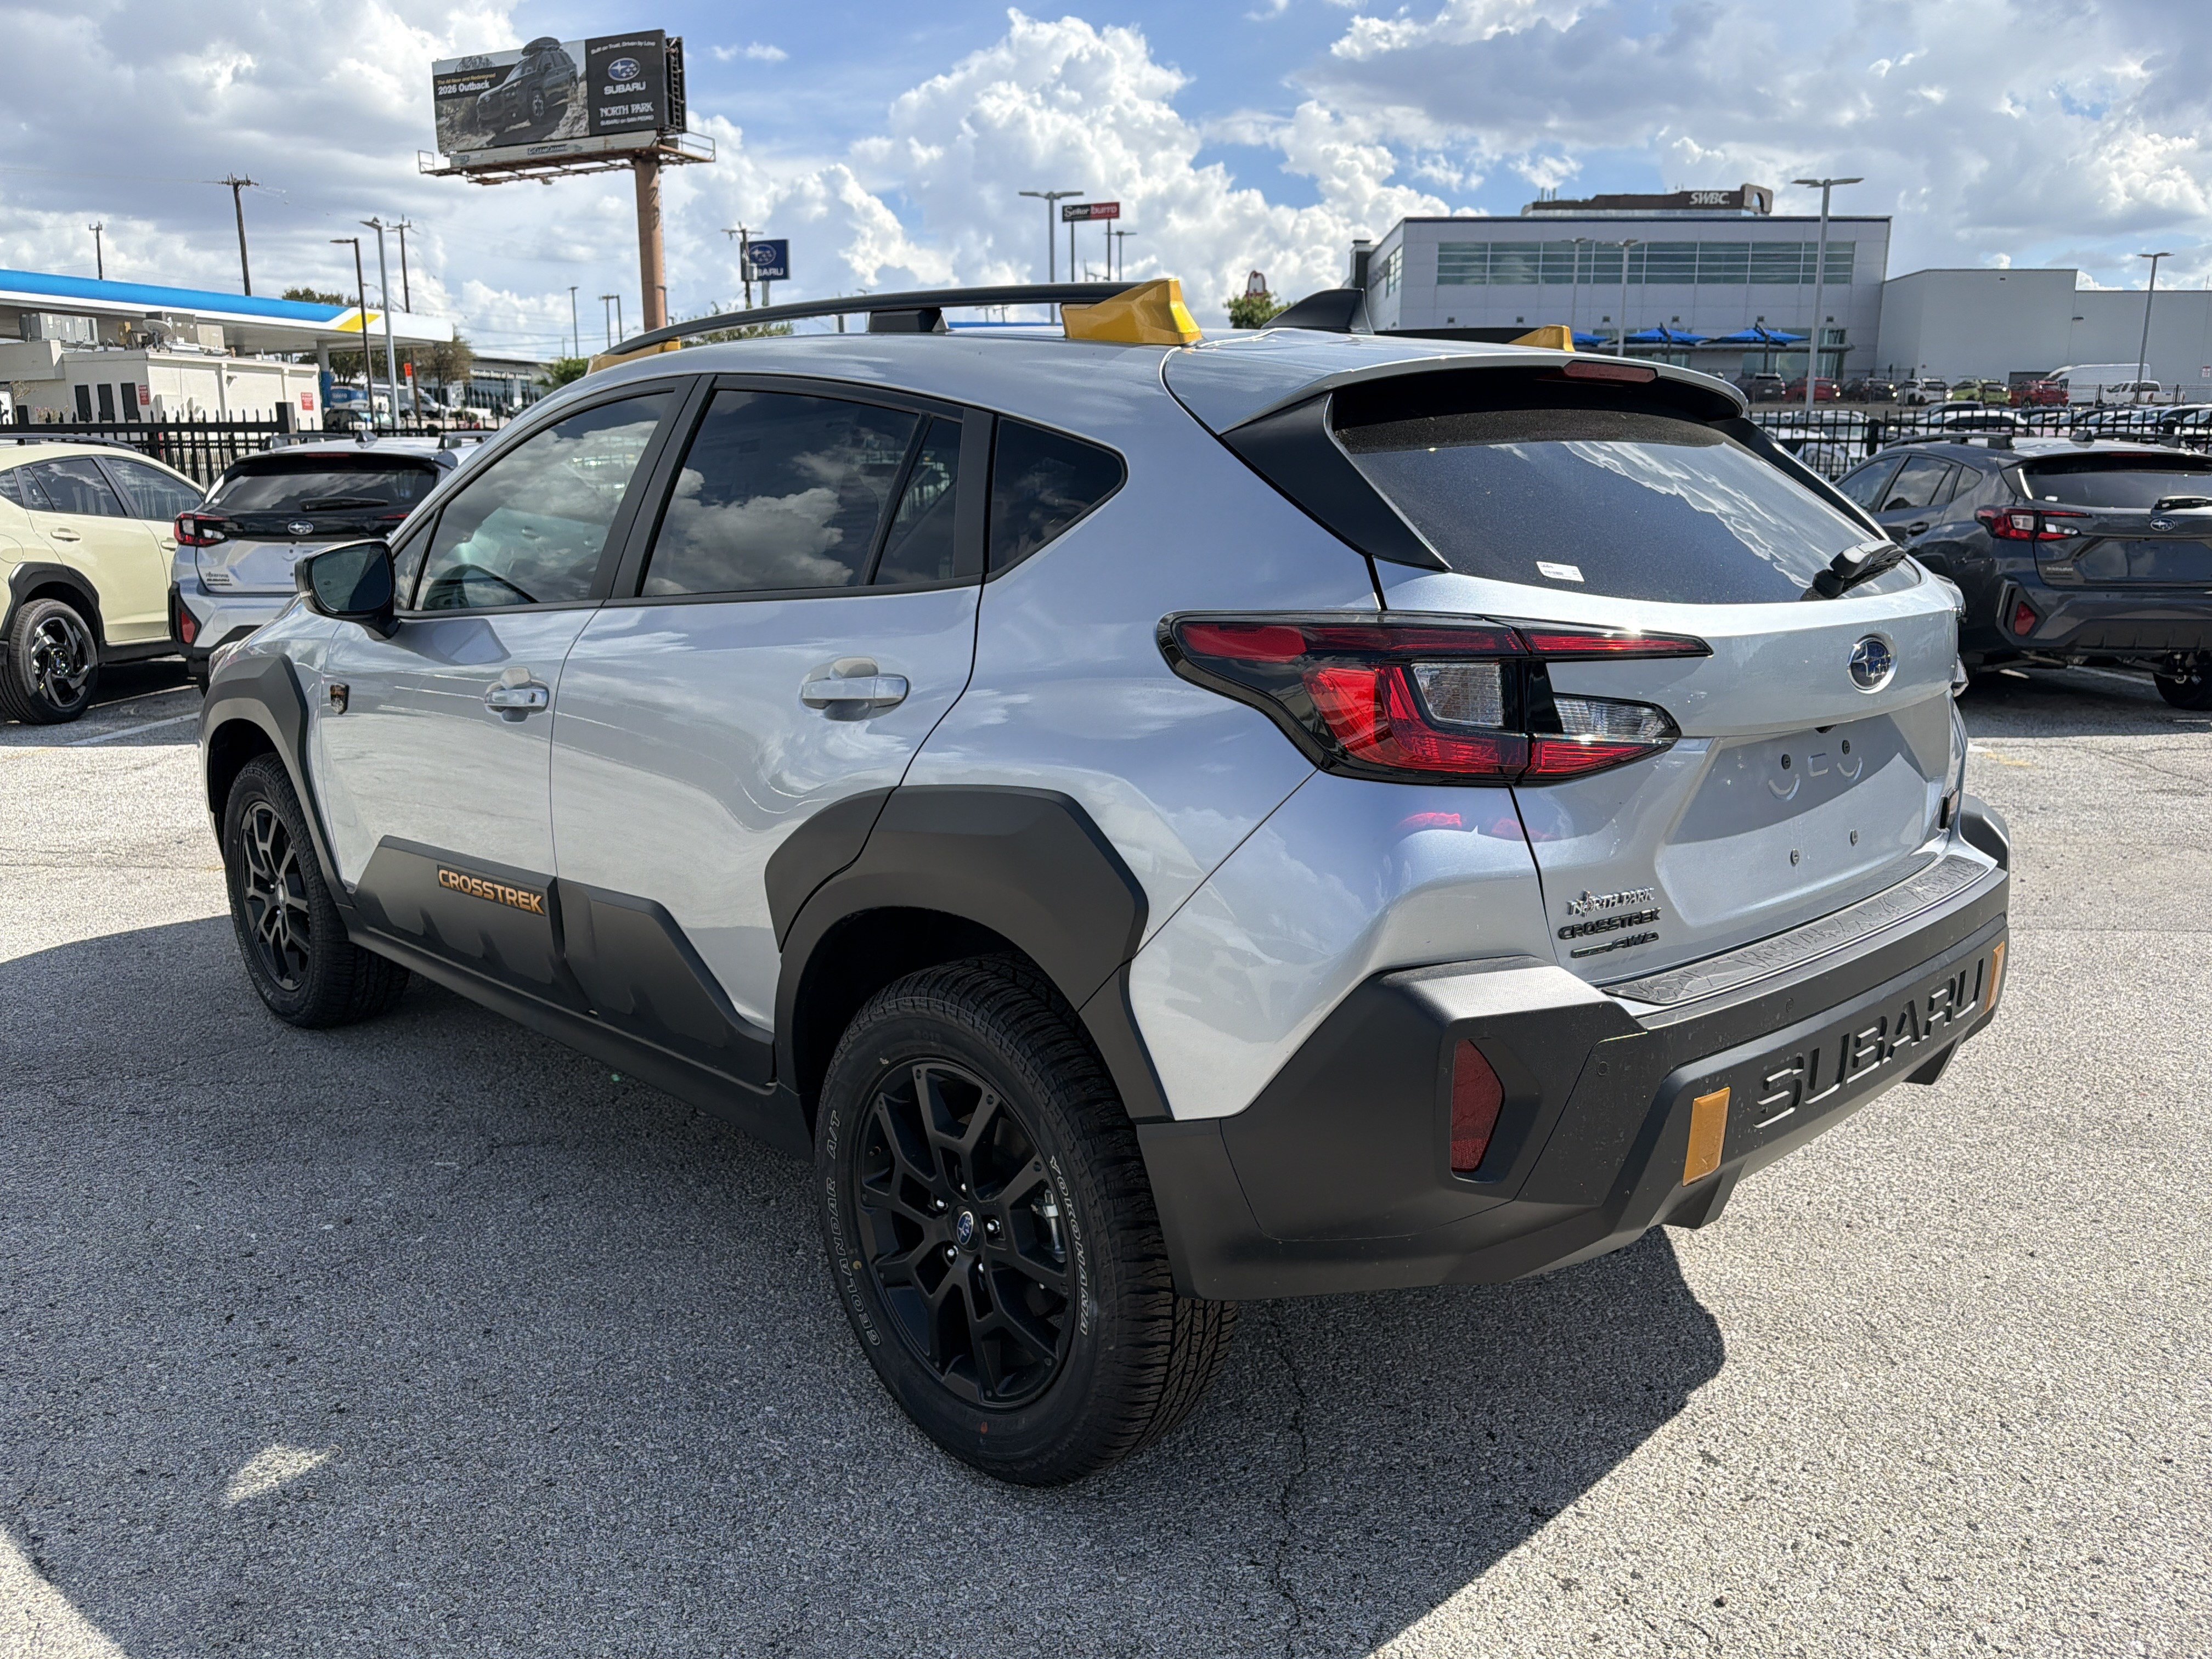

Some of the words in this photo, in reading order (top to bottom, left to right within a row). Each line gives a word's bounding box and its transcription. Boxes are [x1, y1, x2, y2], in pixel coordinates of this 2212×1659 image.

[437, 84, 458, 95] 2026
[458, 80, 490, 93] Outback
[603, 81, 646, 95] SUBARU
[599, 104, 629, 117] NORTH
[630, 101, 654, 114] PARK
[1689, 192, 1730, 205] SWBC
[757, 267, 784, 276] BARU
[439, 868, 545, 916] CROSSTREK
[1621, 887, 1655, 906] PARK
[1557, 907, 1662, 940] CROSSTREK
[1610, 930, 1660, 950] AWD
[1753, 957, 1985, 1129] SUBARU
[827, 1110, 842, 1160] A/T
[1049, 1154, 1090, 1336] YOKOHAMA
[826, 1176, 881, 1346] GEOLANDAR
